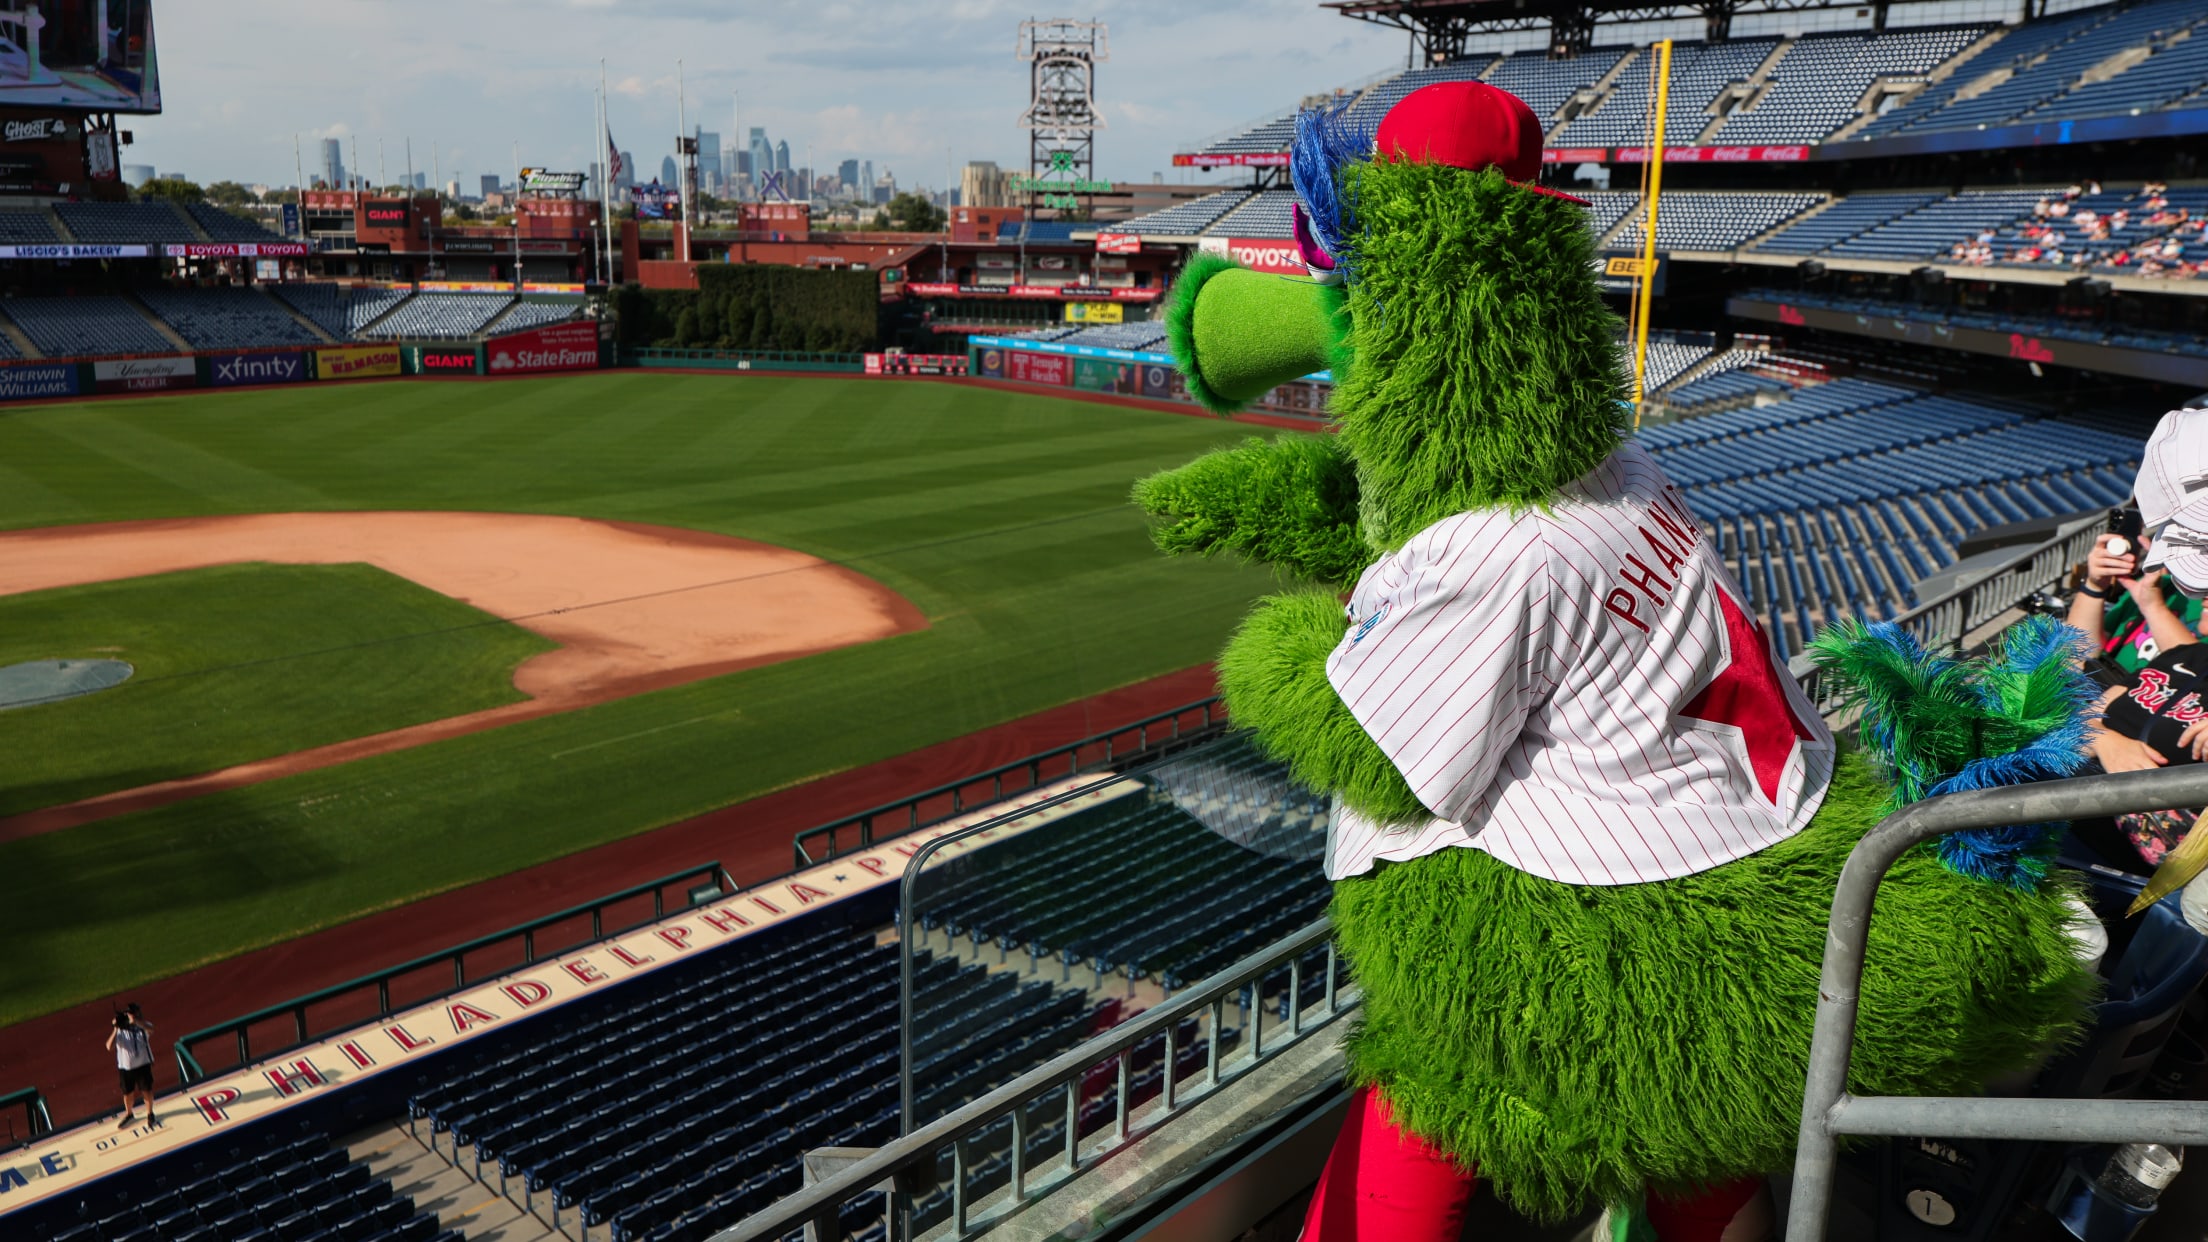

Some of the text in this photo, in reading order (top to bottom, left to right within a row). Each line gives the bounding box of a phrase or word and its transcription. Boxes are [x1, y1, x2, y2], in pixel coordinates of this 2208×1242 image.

[5, 118, 53, 141] GHOST
[1010, 175, 1113, 192] Citizens Bank
[1043, 192, 1078, 208] Park
[368, 210, 405, 220] GIANT
[15, 246, 122, 256] LISCIO'S BAKERY
[190, 244, 235, 255] TOYOTA
[262, 244, 304, 254] TOYOTA
[1231, 247, 1301, 267] TOYOTA
[218, 355, 297, 381] xfinity
[423, 355, 475, 368] GIANT
[1031, 355, 1064, 370] Temple
[0, 368, 66, 383] SHERWIN
[1030, 369, 1062, 384] Health
[127, 377, 168, 390] LAGER
[190, 882, 834, 1126] PHILADELPHIA
[96, 1136, 120, 1151] OF
[130, 1119, 167, 1139] THE
